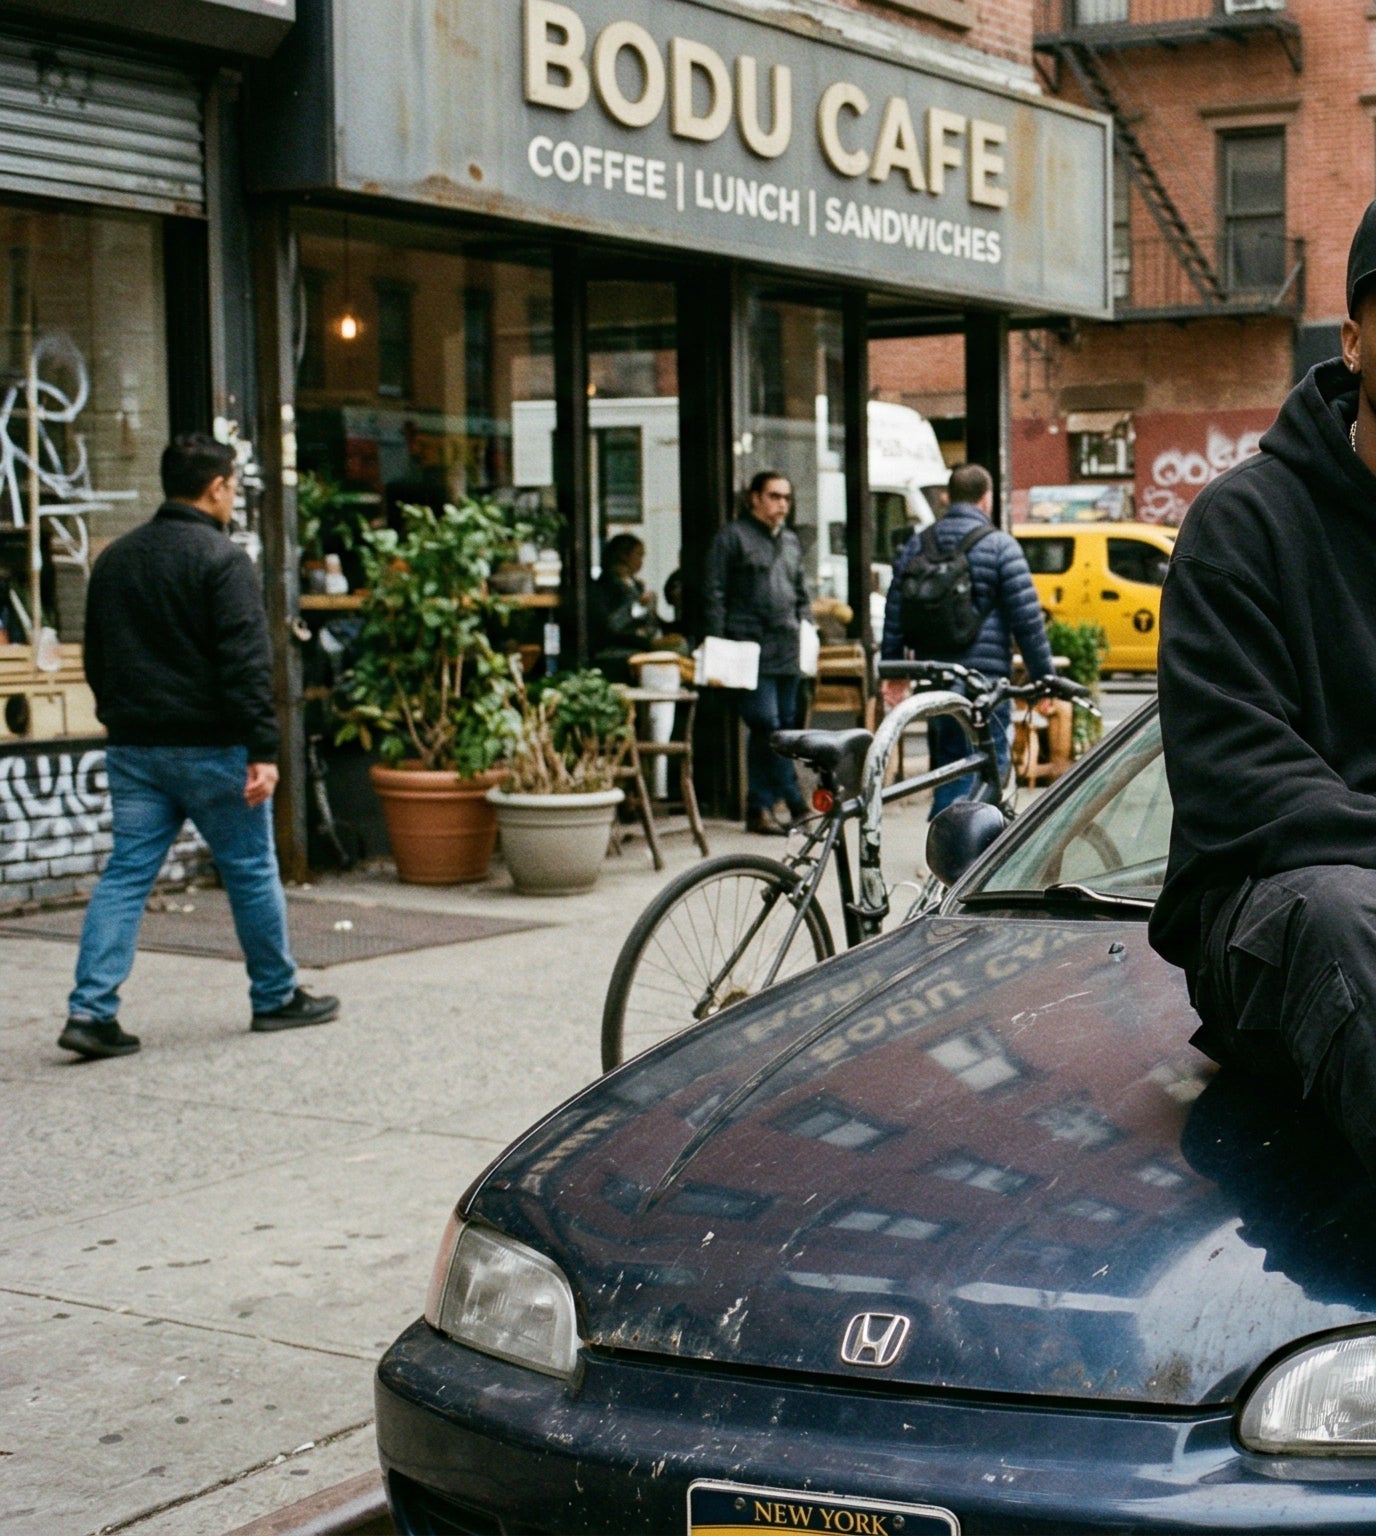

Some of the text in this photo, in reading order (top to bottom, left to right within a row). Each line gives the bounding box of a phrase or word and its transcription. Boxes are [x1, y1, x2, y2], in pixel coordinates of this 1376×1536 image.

[523, 0, 1009, 207] BODU CAFE
[528, 136, 666, 199] COFFEE
[695, 170, 799, 226] LUNCH
[825, 198, 1001, 264] SANDWICHES
[754, 1501, 889, 1536] NEW YORK
